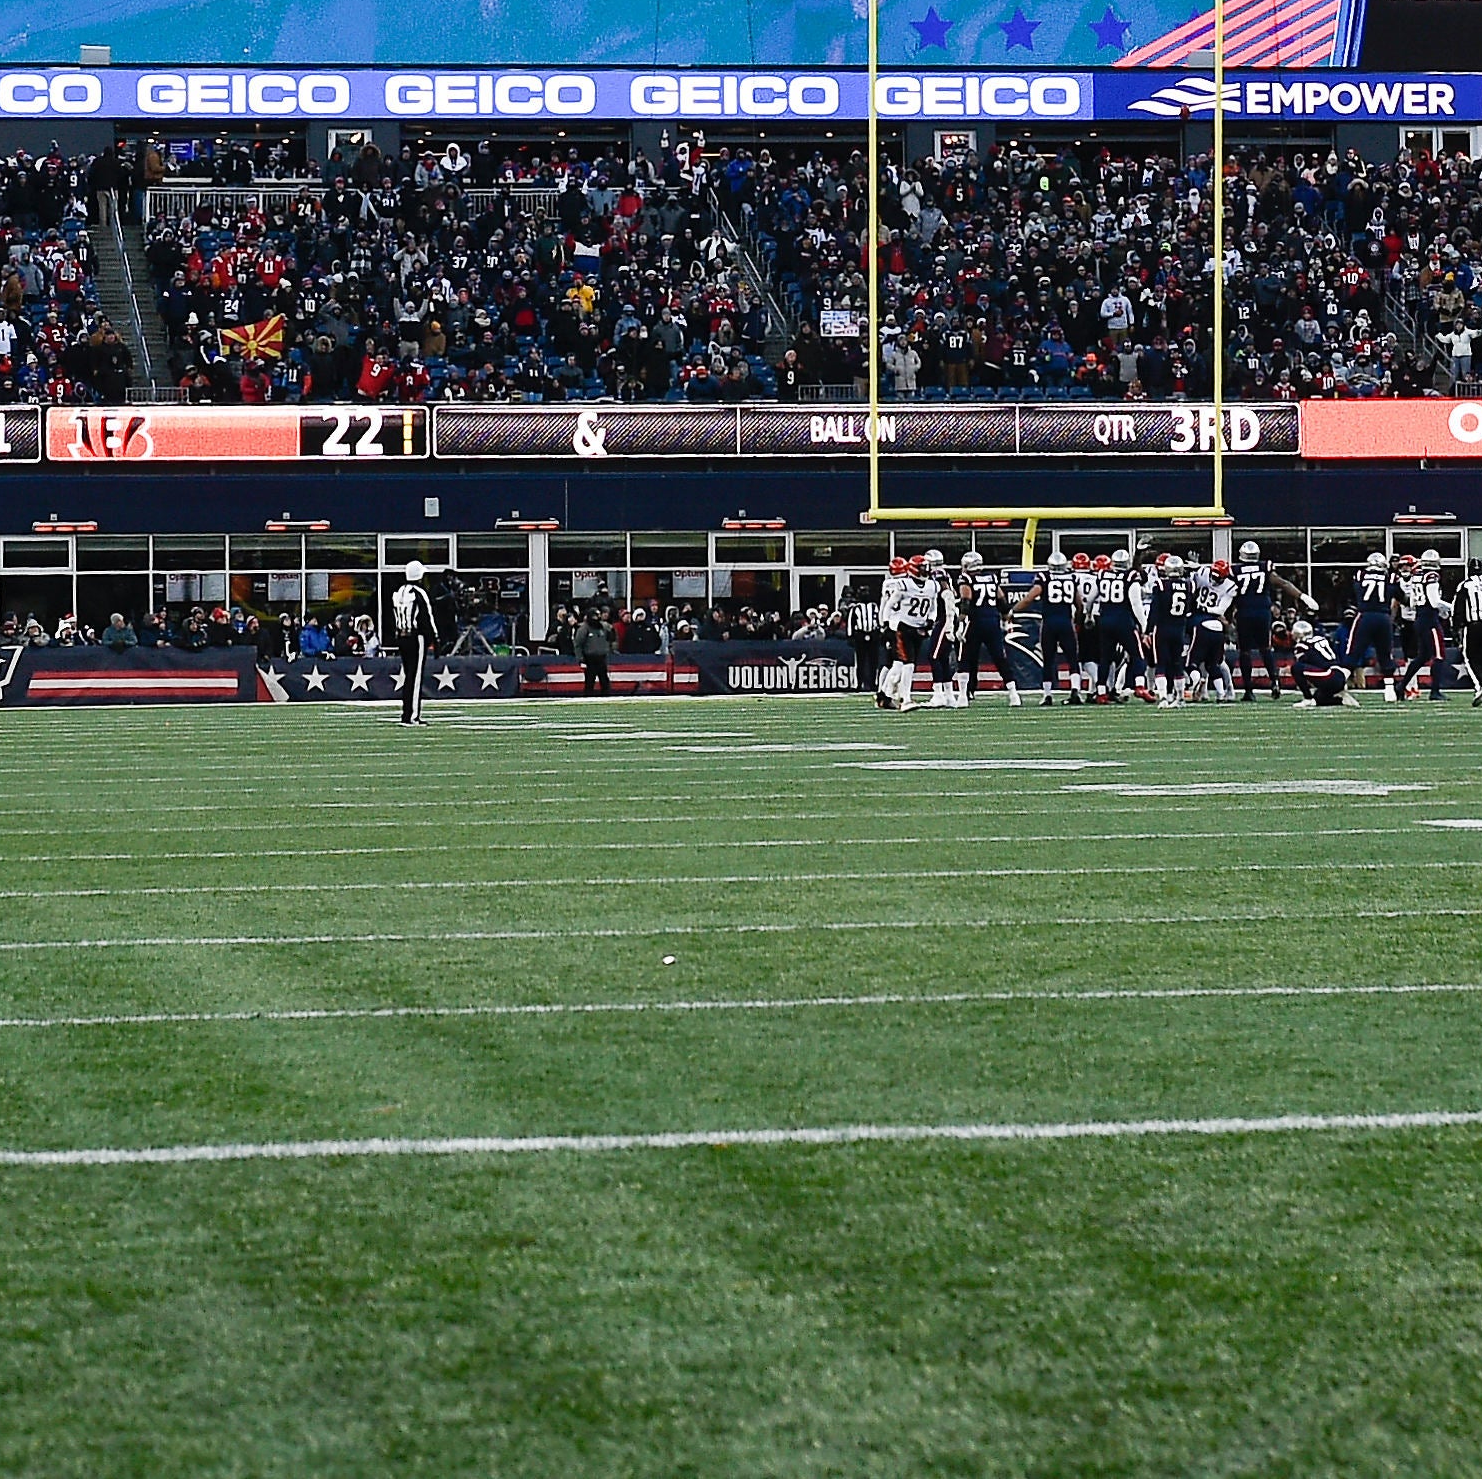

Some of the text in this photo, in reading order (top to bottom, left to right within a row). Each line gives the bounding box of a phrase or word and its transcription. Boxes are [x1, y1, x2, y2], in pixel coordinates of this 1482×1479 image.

[135, 74, 353, 116] GEICO
[383, 74, 598, 116] GEICO
[629, 75, 839, 116] GEICO
[874, 76, 1081, 116] GEICO
[1245, 83, 1454, 116] EMPOWER
[321, 408, 384, 456] 22
[571, 412, 608, 457] &
[809, 417, 897, 443] BALL ON
[1092, 416, 1136, 443] QTR
[1169, 409, 1261, 452] 3RD
[972, 583, 997, 606] 75
[1047, 581, 1074, 604] 69
[1100, 579, 1124, 603] 98
[1237, 572, 1266, 594] 77
[1361, 579, 1386, 602] 71
[907, 597, 930, 617] 20
[1171, 592, 1187, 616] 6
[1200, 588, 1219, 608] 93
